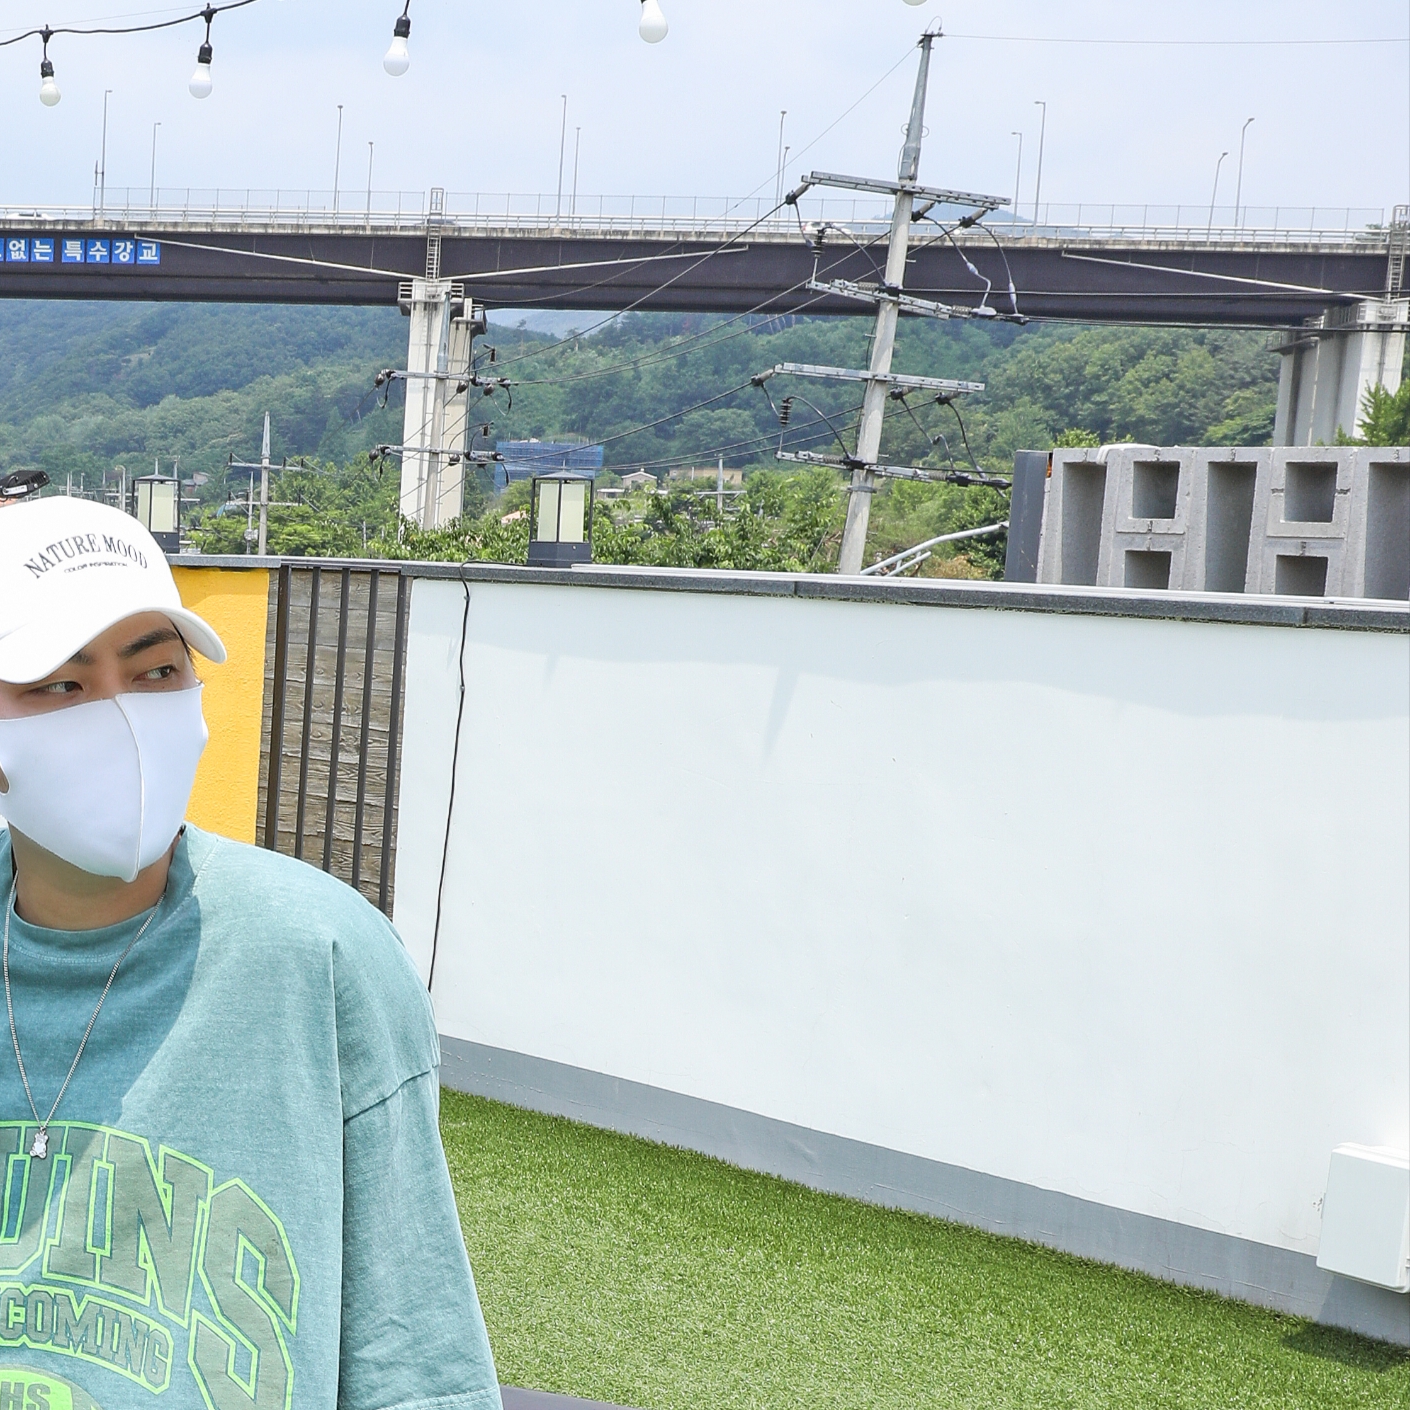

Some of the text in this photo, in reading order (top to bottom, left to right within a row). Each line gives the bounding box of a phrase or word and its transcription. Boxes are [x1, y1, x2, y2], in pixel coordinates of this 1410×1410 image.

[63, 240, 159, 262] 특수강교
[23, 533, 148, 579] NATURE MOOD
